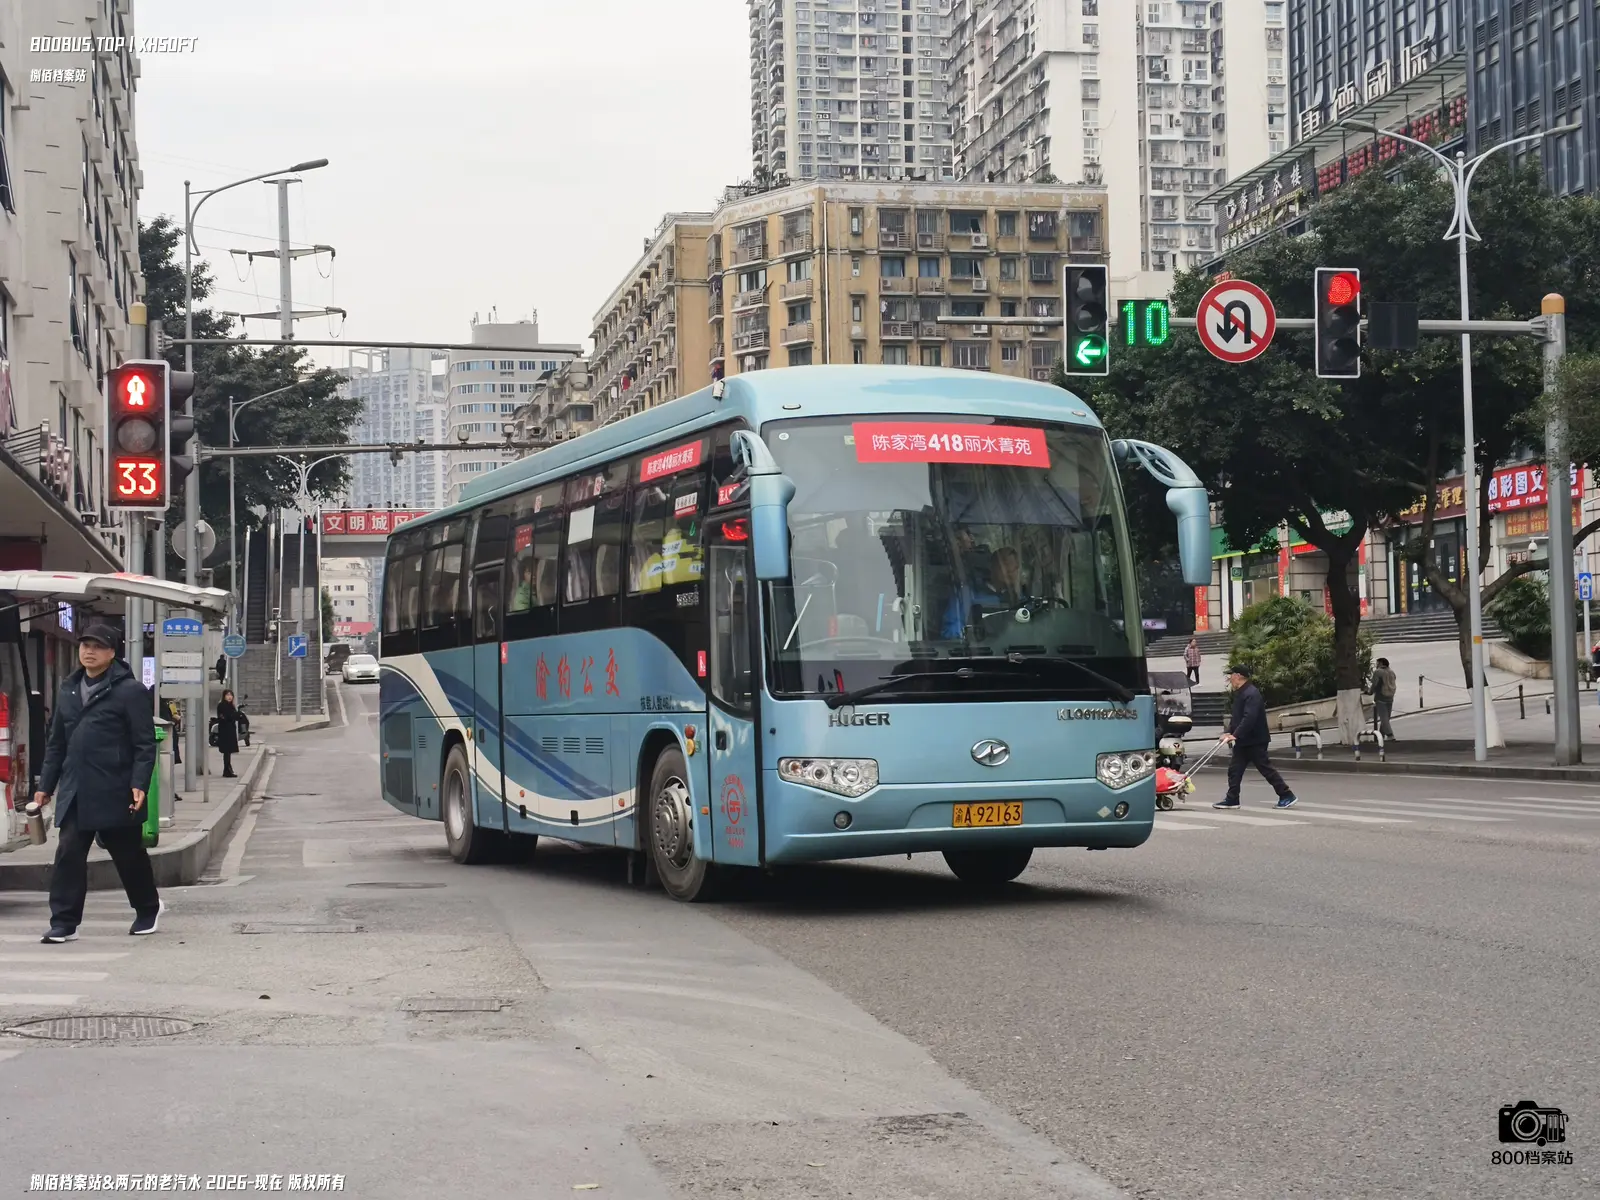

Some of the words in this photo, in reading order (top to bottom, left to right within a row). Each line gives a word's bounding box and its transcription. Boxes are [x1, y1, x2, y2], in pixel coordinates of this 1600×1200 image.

[1122, 301, 1168, 345] 10
[872, 434, 1032, 455] 陈家湾418丽水菁苑
[118, 463, 157, 494] 33
[326, 516, 415, 531] 文明城区
[828, 713, 890, 727] HIGER
